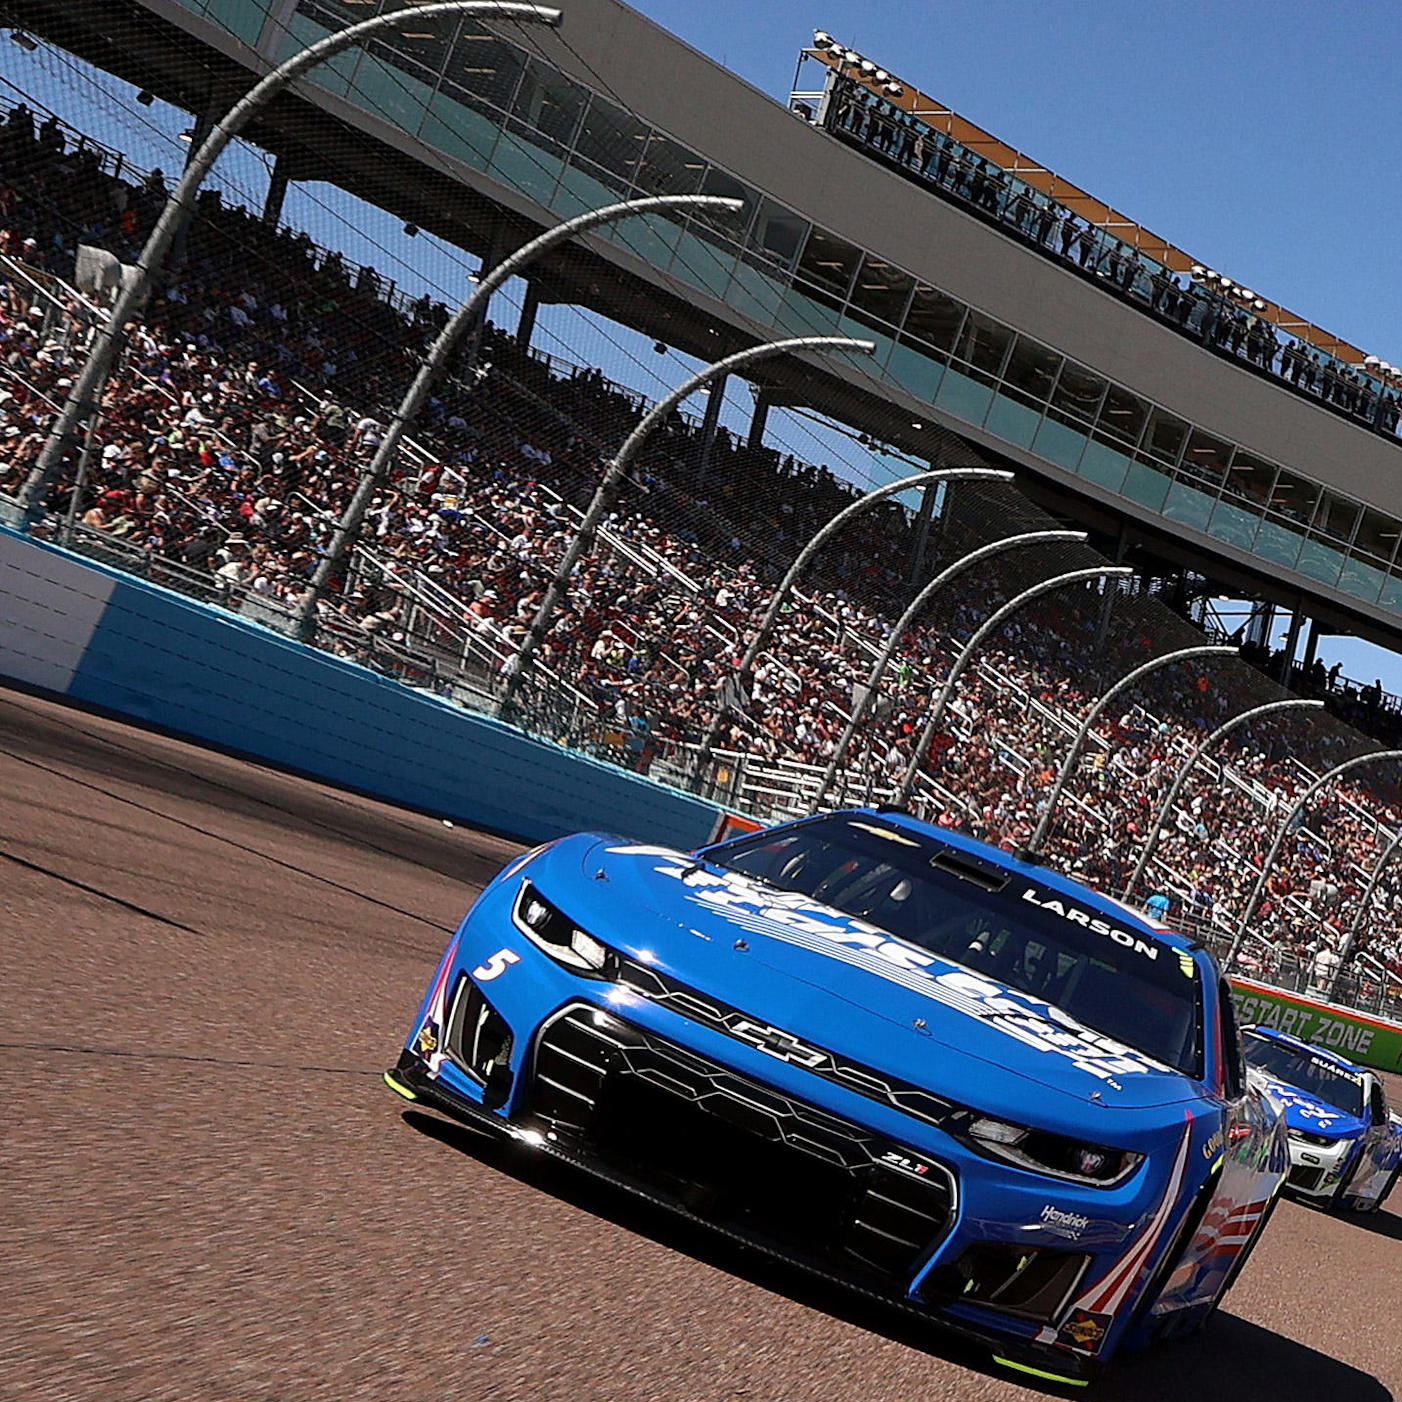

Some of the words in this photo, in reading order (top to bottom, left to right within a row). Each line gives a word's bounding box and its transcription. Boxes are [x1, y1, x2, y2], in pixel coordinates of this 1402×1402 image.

[1022, 889, 1158, 960] LARSON
[472, 947, 522, 981] 5
[1230, 993, 1312, 1038] ESTART
[1310, 1018, 1375, 1054] ZONE
[881, 1151, 929, 1175] ZL1
[1041, 1204, 1089, 1230] Hendrick
